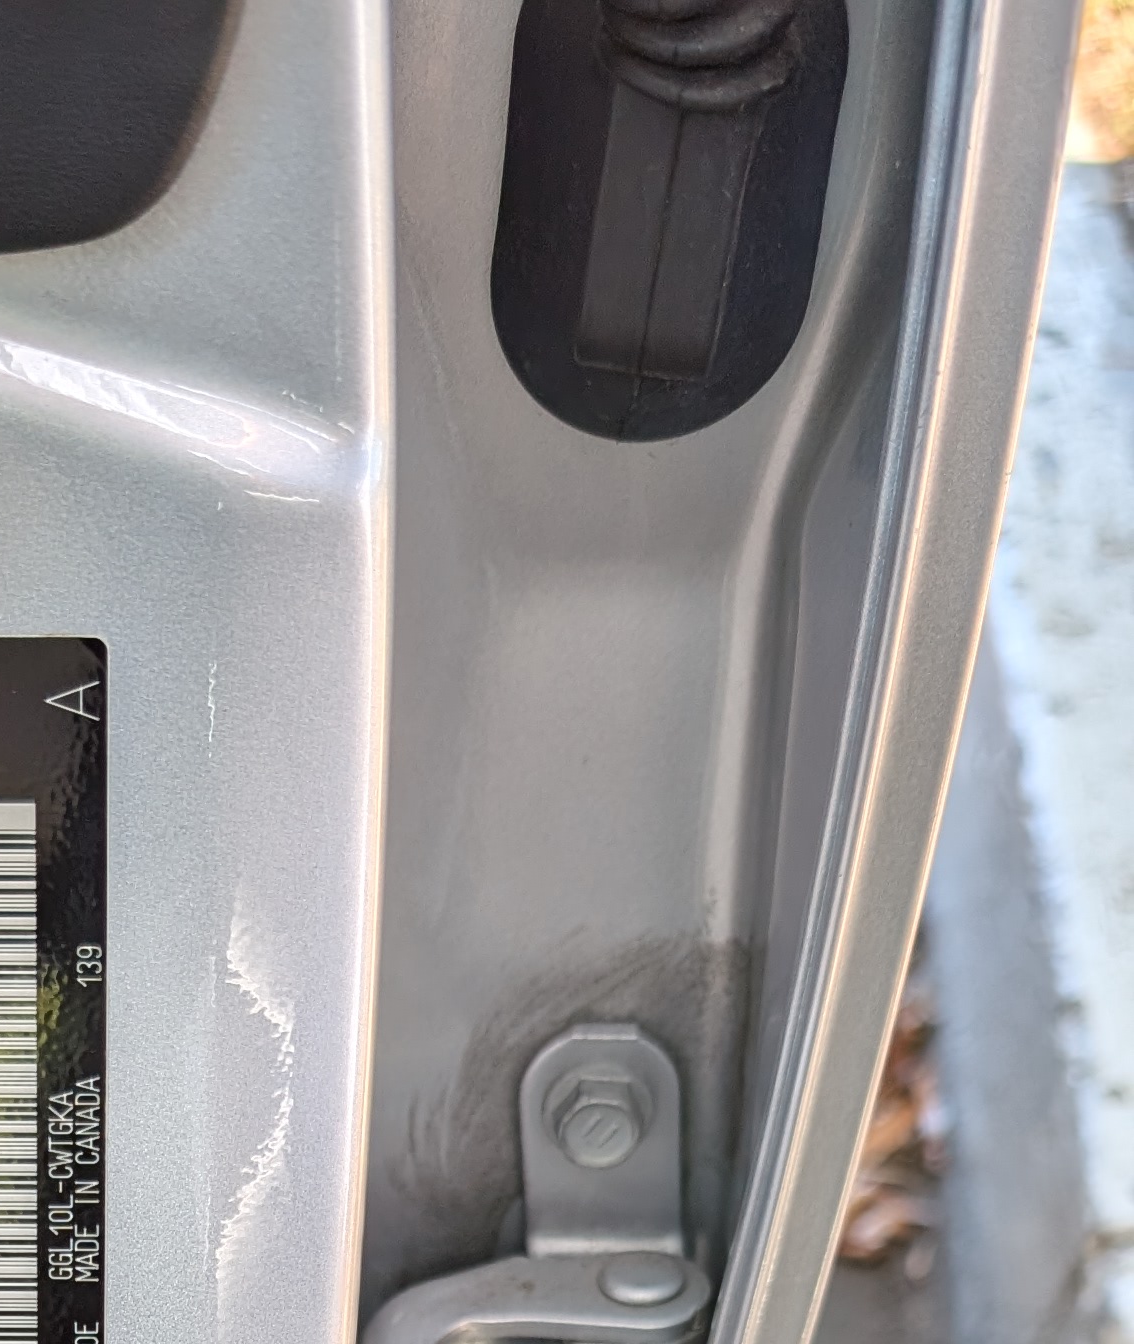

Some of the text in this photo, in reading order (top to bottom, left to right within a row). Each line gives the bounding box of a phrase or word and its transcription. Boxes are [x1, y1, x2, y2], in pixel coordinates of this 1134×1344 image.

[44, 681, 100, 720] A
[77, 945, 102, 986] 139
[76, 1077, 101, 1164] CANADA
[76, 1182, 101, 1204] IN
[76, 1226, 101, 1282] MADE
